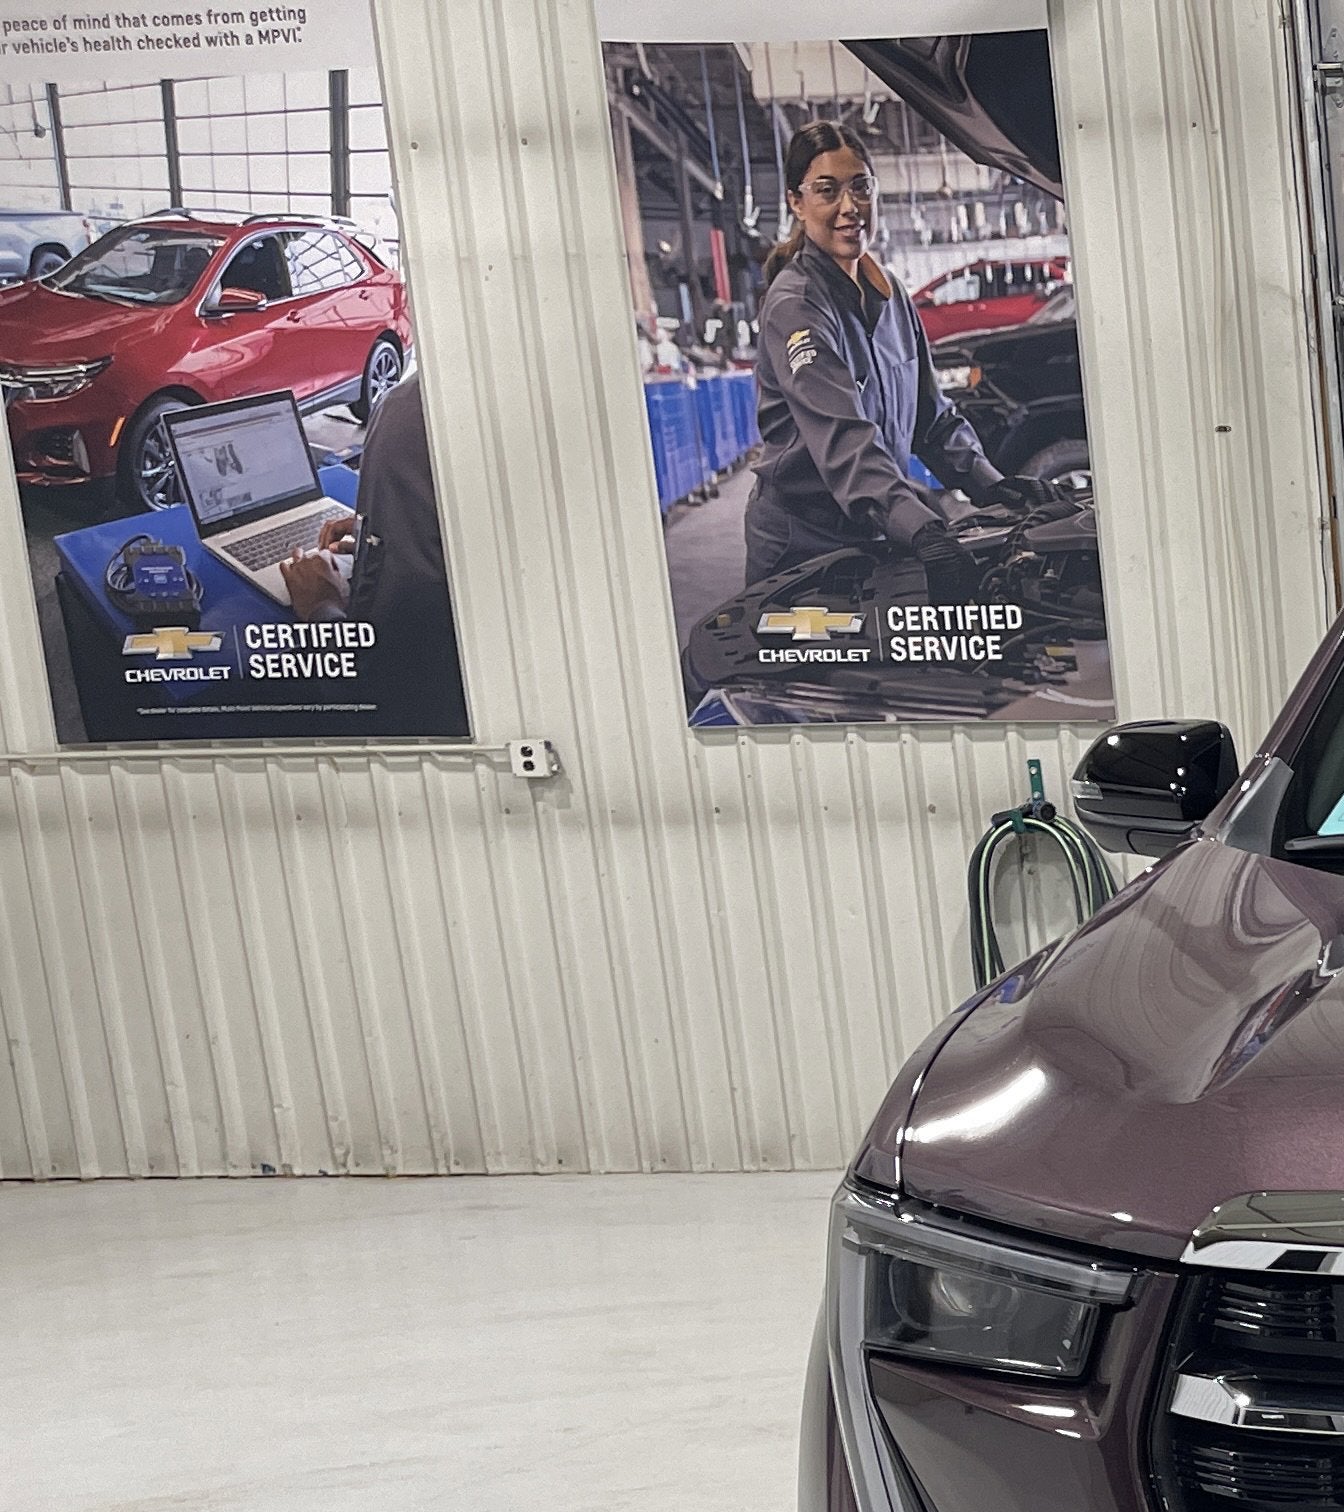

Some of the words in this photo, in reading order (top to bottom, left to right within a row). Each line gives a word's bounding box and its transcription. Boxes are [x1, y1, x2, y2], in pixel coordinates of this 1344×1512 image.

[2, 19, 48, 36] peace
[52, 14, 67, 30] of
[72, 13, 111, 30] mind
[114, 12, 148, 28] that
[152, 13, 203, 27] comes
[206, 9, 245, 25] from
[249, 5, 307, 27] getting
[12, 37, 79, 54] vehicle's
[82, 35, 132, 52] health
[136, 32, 202, 50] checked
[204, 30, 241, 48] with
[245, 33, 254, 45] a
[887, 604, 1024, 632] CERTIFIED
[244, 622, 376, 650] CERTIFIED
[890, 635, 1004, 662] SERVICE
[249, 652, 358, 680] SERVICE
[758, 648, 872, 663] CHEVROLET
[124, 665, 232, 683] CHEVROLET
